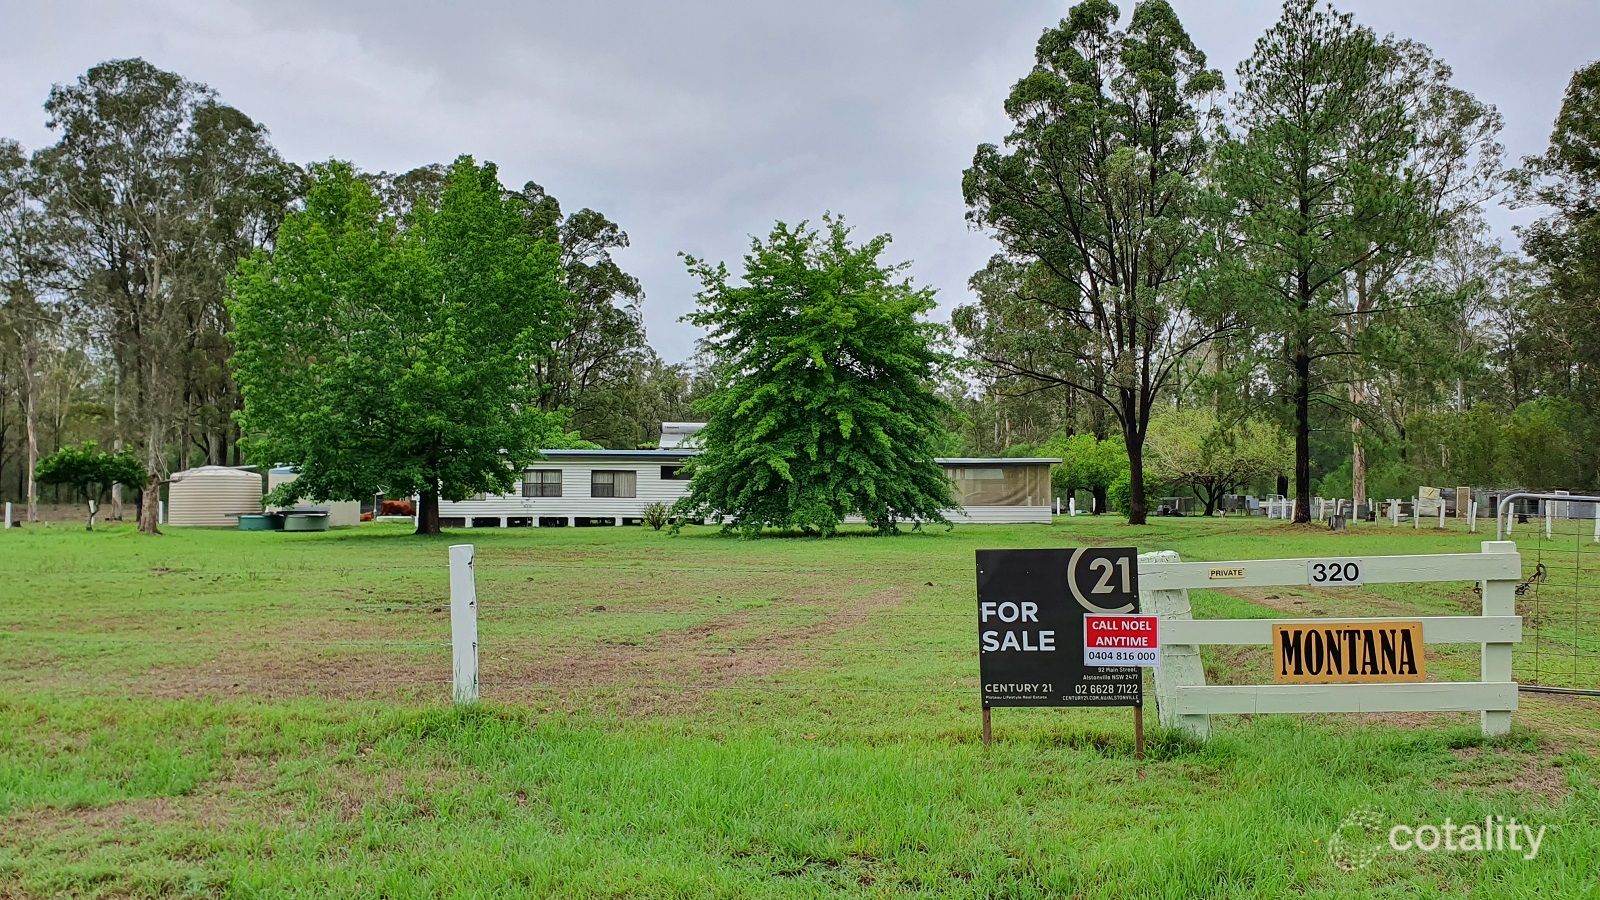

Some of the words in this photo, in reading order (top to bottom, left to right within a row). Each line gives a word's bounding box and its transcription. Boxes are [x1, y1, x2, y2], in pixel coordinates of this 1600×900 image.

[1210, 569, 1243, 577] PRIVATE
[1312, 562, 1360, 583] 320
[981, 601, 1039, 623] FOR
[1092, 621, 1118, 631] CALL
[1121, 621, 1152, 631] NOEL
[982, 630, 1056, 652] SALE
[1095, 636, 1149, 647] ANYTIME
[1088, 651, 1114, 661] 0404
[1116, 652, 1135, 661] 816
[1137, 652, 1156, 661] 000
[1280, 629, 1418, 676] MONTANA
[985, 684, 1039, 693] CENTURY
[1075, 684, 1088, 695] 02
[1090, 684, 1115, 695] 6628
[1117, 684, 1139, 694] 7122
